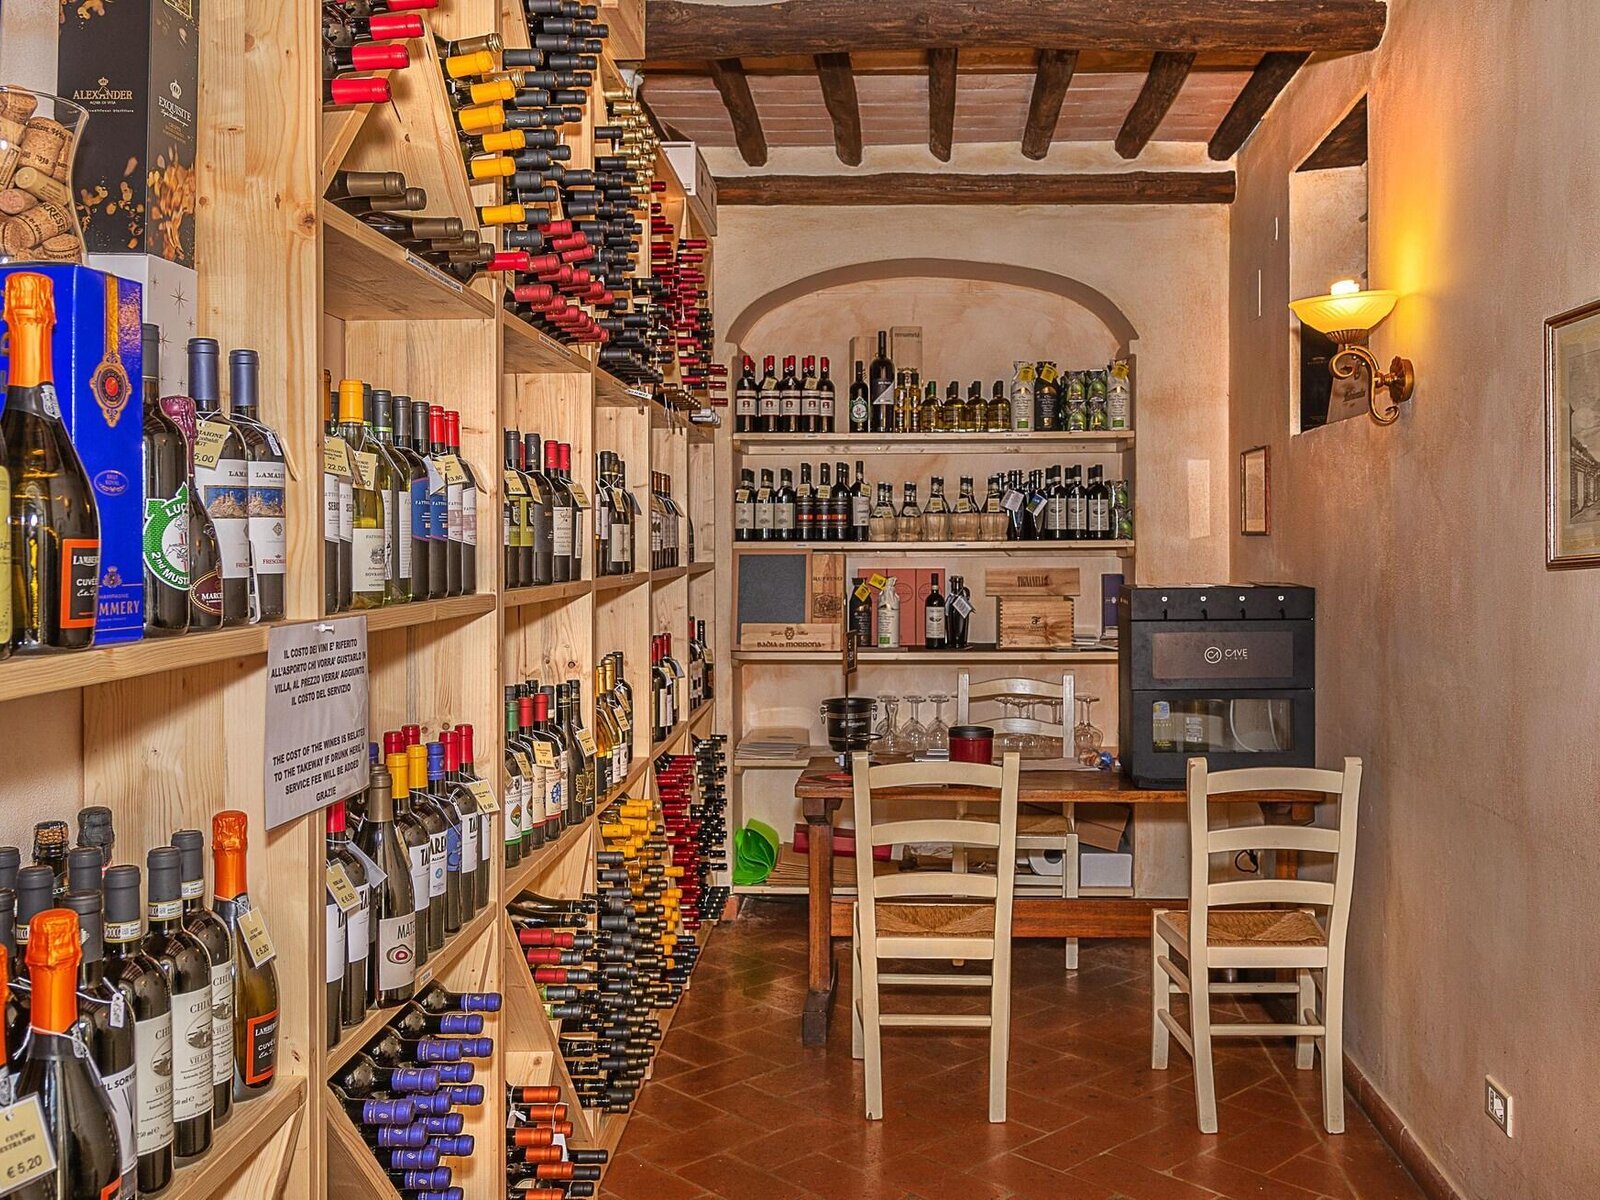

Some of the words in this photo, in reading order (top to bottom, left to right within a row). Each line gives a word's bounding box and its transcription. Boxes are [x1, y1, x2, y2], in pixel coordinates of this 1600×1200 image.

[73, 89, 133, 100] ALEXANDER
[158, 96, 192, 122] EXQUISITE
[283, 650, 289, 659] IL
[290, 647, 308, 658] COSTO
[309, 645, 317, 655] DEI
[318, 643, 328, 653] VINI
[335, 638, 358, 650] RIFERITO
[1225, 649, 1247, 657] CAVE
[270, 662, 307, 678] ALL'ASPORTO
[308, 661, 316, 670] CHI
[293, 680, 299, 689] AL
[300, 676, 320, 688] PREZZO
[340, 666, 364, 679] AGGIUNTO
[291, 697, 297, 706] IL
[298, 691, 315, 704] COSTO
[316, 689, 326, 700] DEL
[327, 683, 351, 697] SERVIZIO
[272, 754, 285, 766] THE
[285, 749, 301, 762] COST
[302, 745, 310, 756] OF
[311, 741, 322, 753] THE
[323, 736, 340, 749] WINES
[341, 734, 346, 743] IS
[274, 772, 283, 782] TO
[283, 766, 295, 779] THE
[296, 757, 323, 774] TAKEWAY
[324, 755, 330, 764] IF
[330, 748, 349, 762] DRUNK
[349, 744, 361, 755] HERE
[285, 777, 310, 795] SERVICE
[311, 773, 322, 785] FEE
[322, 768, 336, 781] WILL
[336, 765, 343, 776] BE
[344, 759, 359, 773] ADDED
[315, 786, 337, 801] GRAZIE
[7, 1165, 16, 1178] €
[17, 1154, 43, 1175] 5,20
